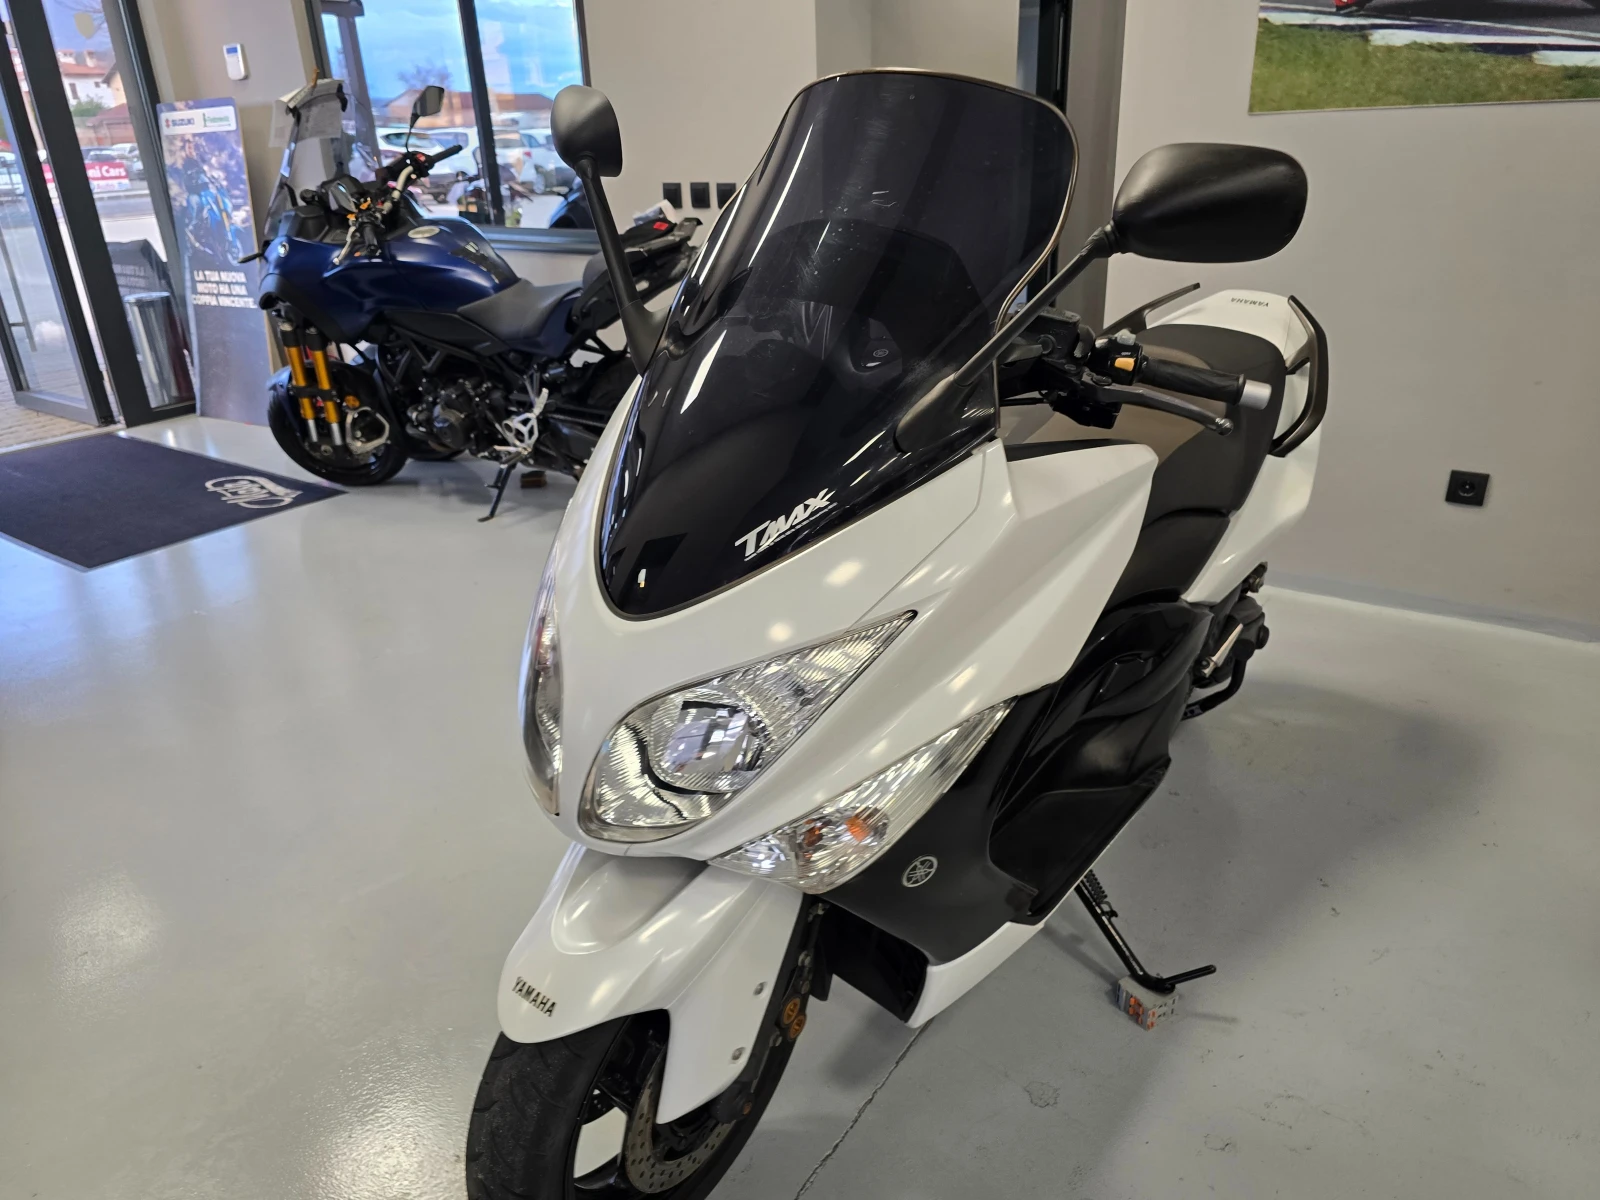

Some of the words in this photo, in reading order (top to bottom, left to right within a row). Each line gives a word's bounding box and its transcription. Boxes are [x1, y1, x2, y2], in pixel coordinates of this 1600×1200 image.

[101, 165, 127, 177] Cars
[193, 269, 205, 281] LA
[204, 270, 220, 282] TUA
[1230, 297, 1269, 308] YAMAHA
[734, 487, 837, 558] TMAX
[512, 976, 557, 1018] YAMAHA
